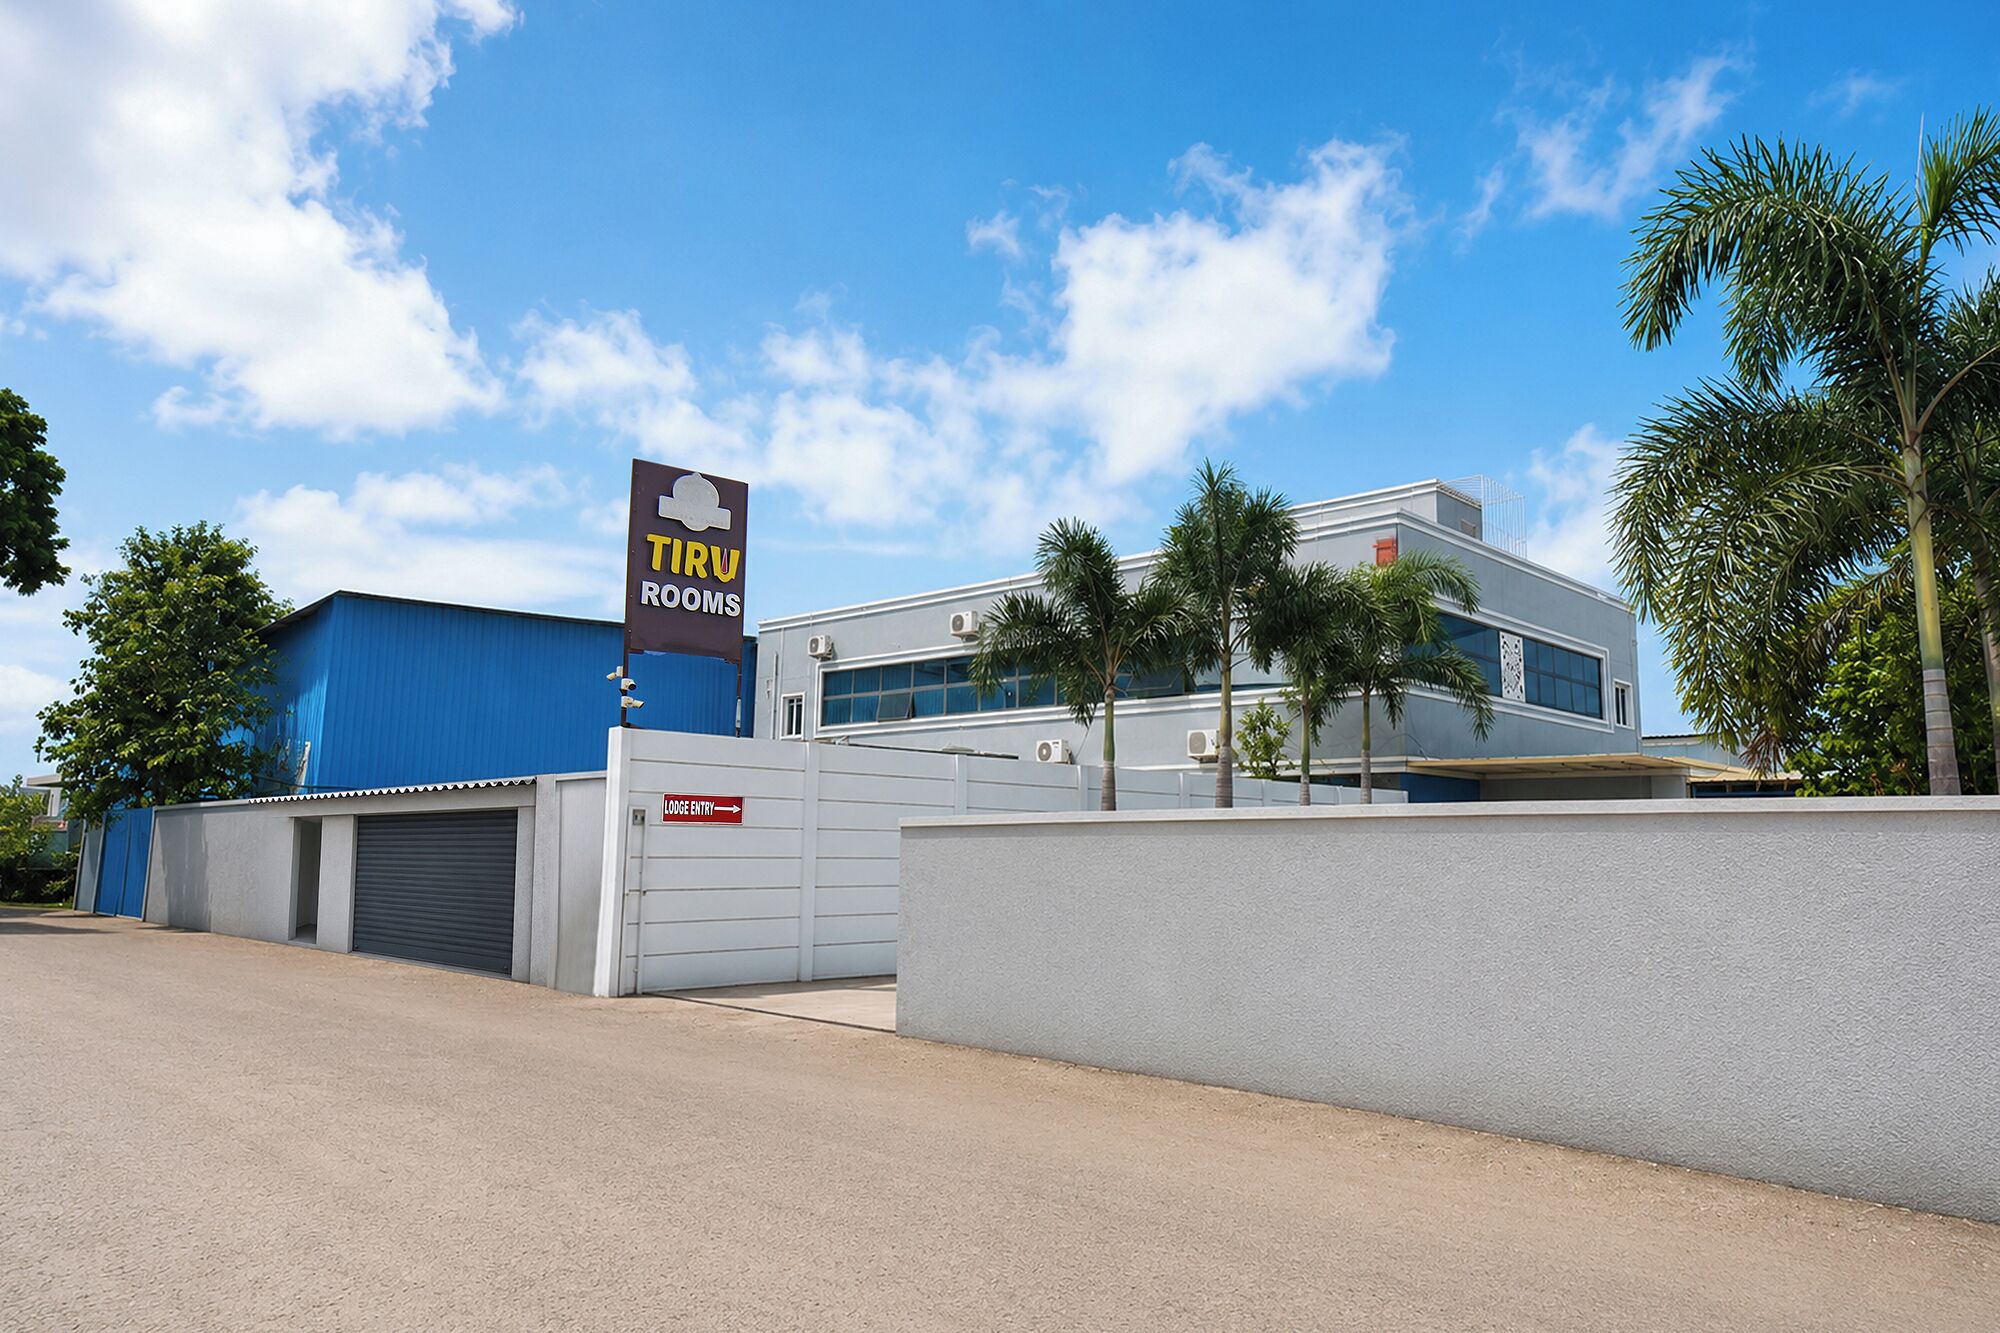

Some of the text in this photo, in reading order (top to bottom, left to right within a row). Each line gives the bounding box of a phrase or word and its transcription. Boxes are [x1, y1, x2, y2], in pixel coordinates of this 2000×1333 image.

[647, 533, 740, 583] TIRU
[641, 580, 741, 617] ROOMS
[664, 799, 715, 816] LODGE ENTRY
